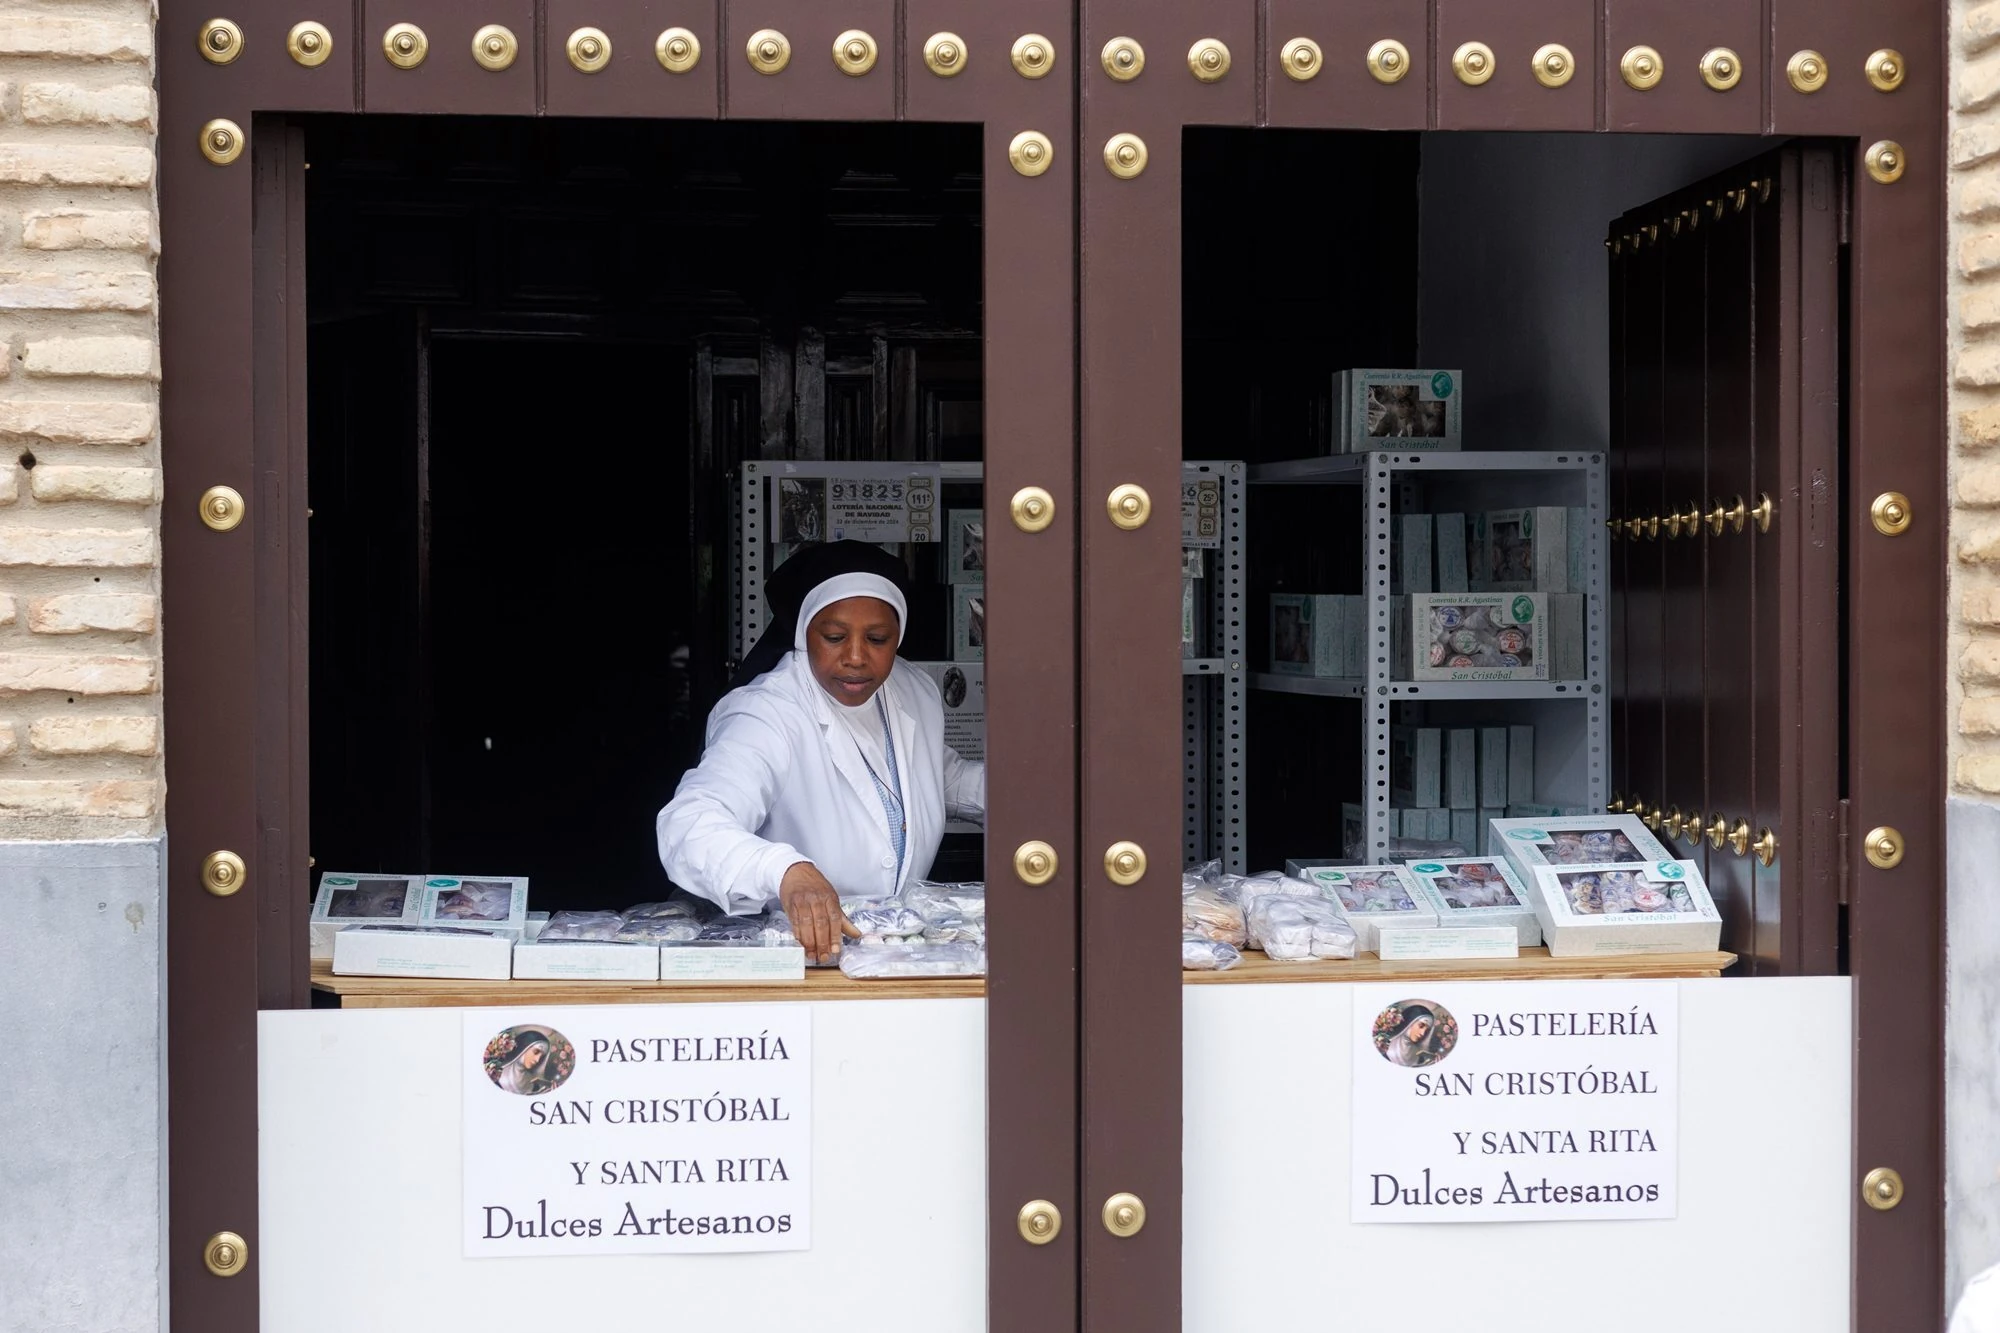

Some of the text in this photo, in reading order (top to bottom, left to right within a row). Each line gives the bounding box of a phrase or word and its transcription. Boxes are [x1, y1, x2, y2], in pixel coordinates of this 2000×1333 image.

[1379, 439, 1439, 449] San Cristóbal
[832, 484, 903, 498] 91825
[915, 533, 926, 542] 20
[1451, 670, 1513, 679] San Cristóbal
[1603, 912, 1677, 922] San Cristóbal
[1473, 1005, 1658, 1036] PASTELERÍA
[591, 1029, 790, 1063] PASTELERÍA
[1415, 1064, 1657, 1096] SAN CRISTÓBAL
[529, 1091, 790, 1126] SAN CRISTÓBAL
[1452, 1129, 1658, 1155] Y SANTA RITA
[570, 1157, 789, 1185] Y SANTA RITA
[1370, 1167, 1659, 1206] Dulces Artesanos
[482, 1199, 792, 1240] Dulces Artesanos
